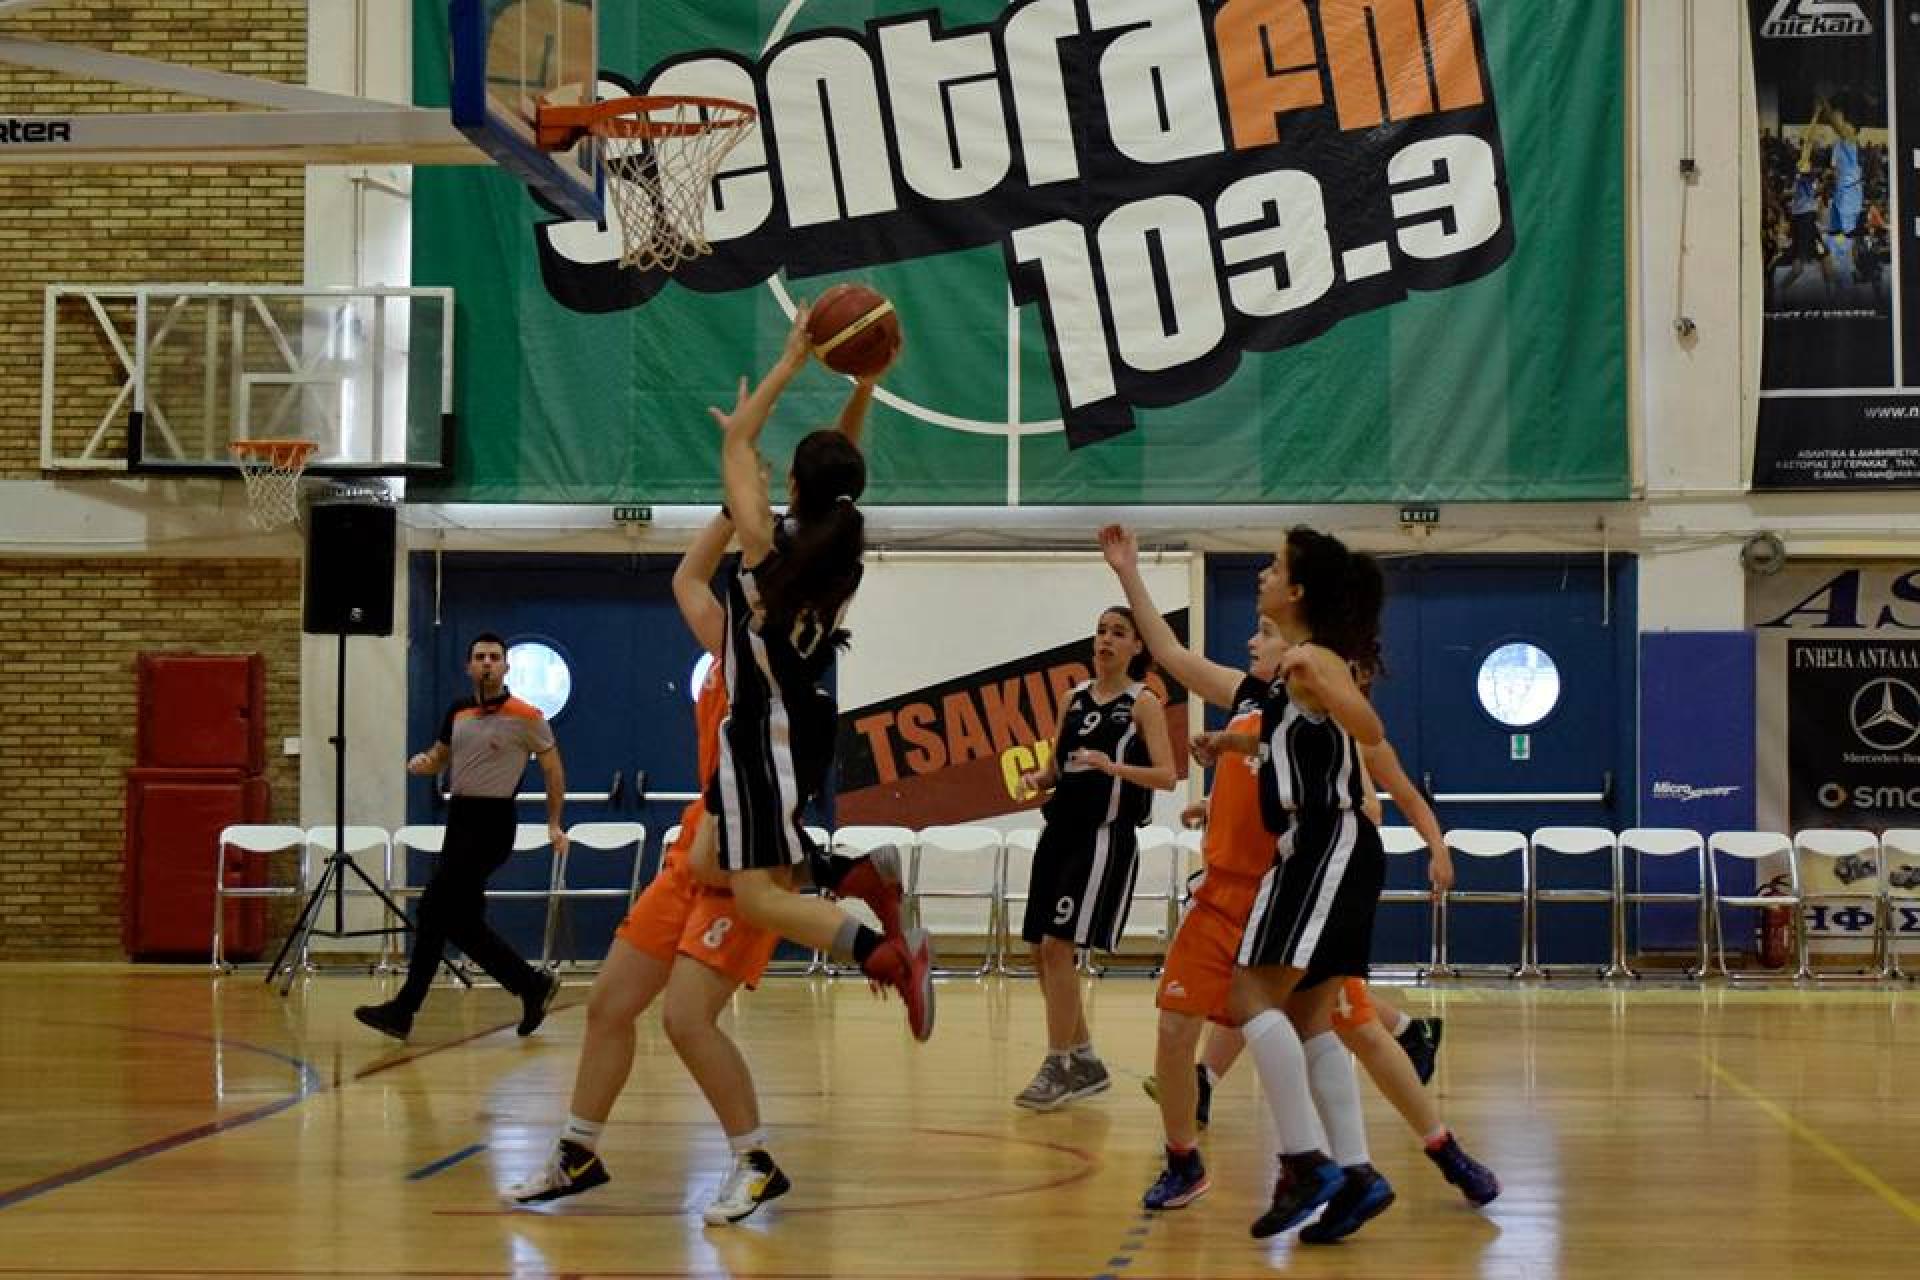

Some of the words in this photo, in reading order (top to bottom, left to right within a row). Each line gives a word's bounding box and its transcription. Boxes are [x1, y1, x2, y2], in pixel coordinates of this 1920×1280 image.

[1011, 133, 1502, 409] 103.3
[1077, 711, 1101, 735] 9
[1053, 896, 1074, 925] 9
